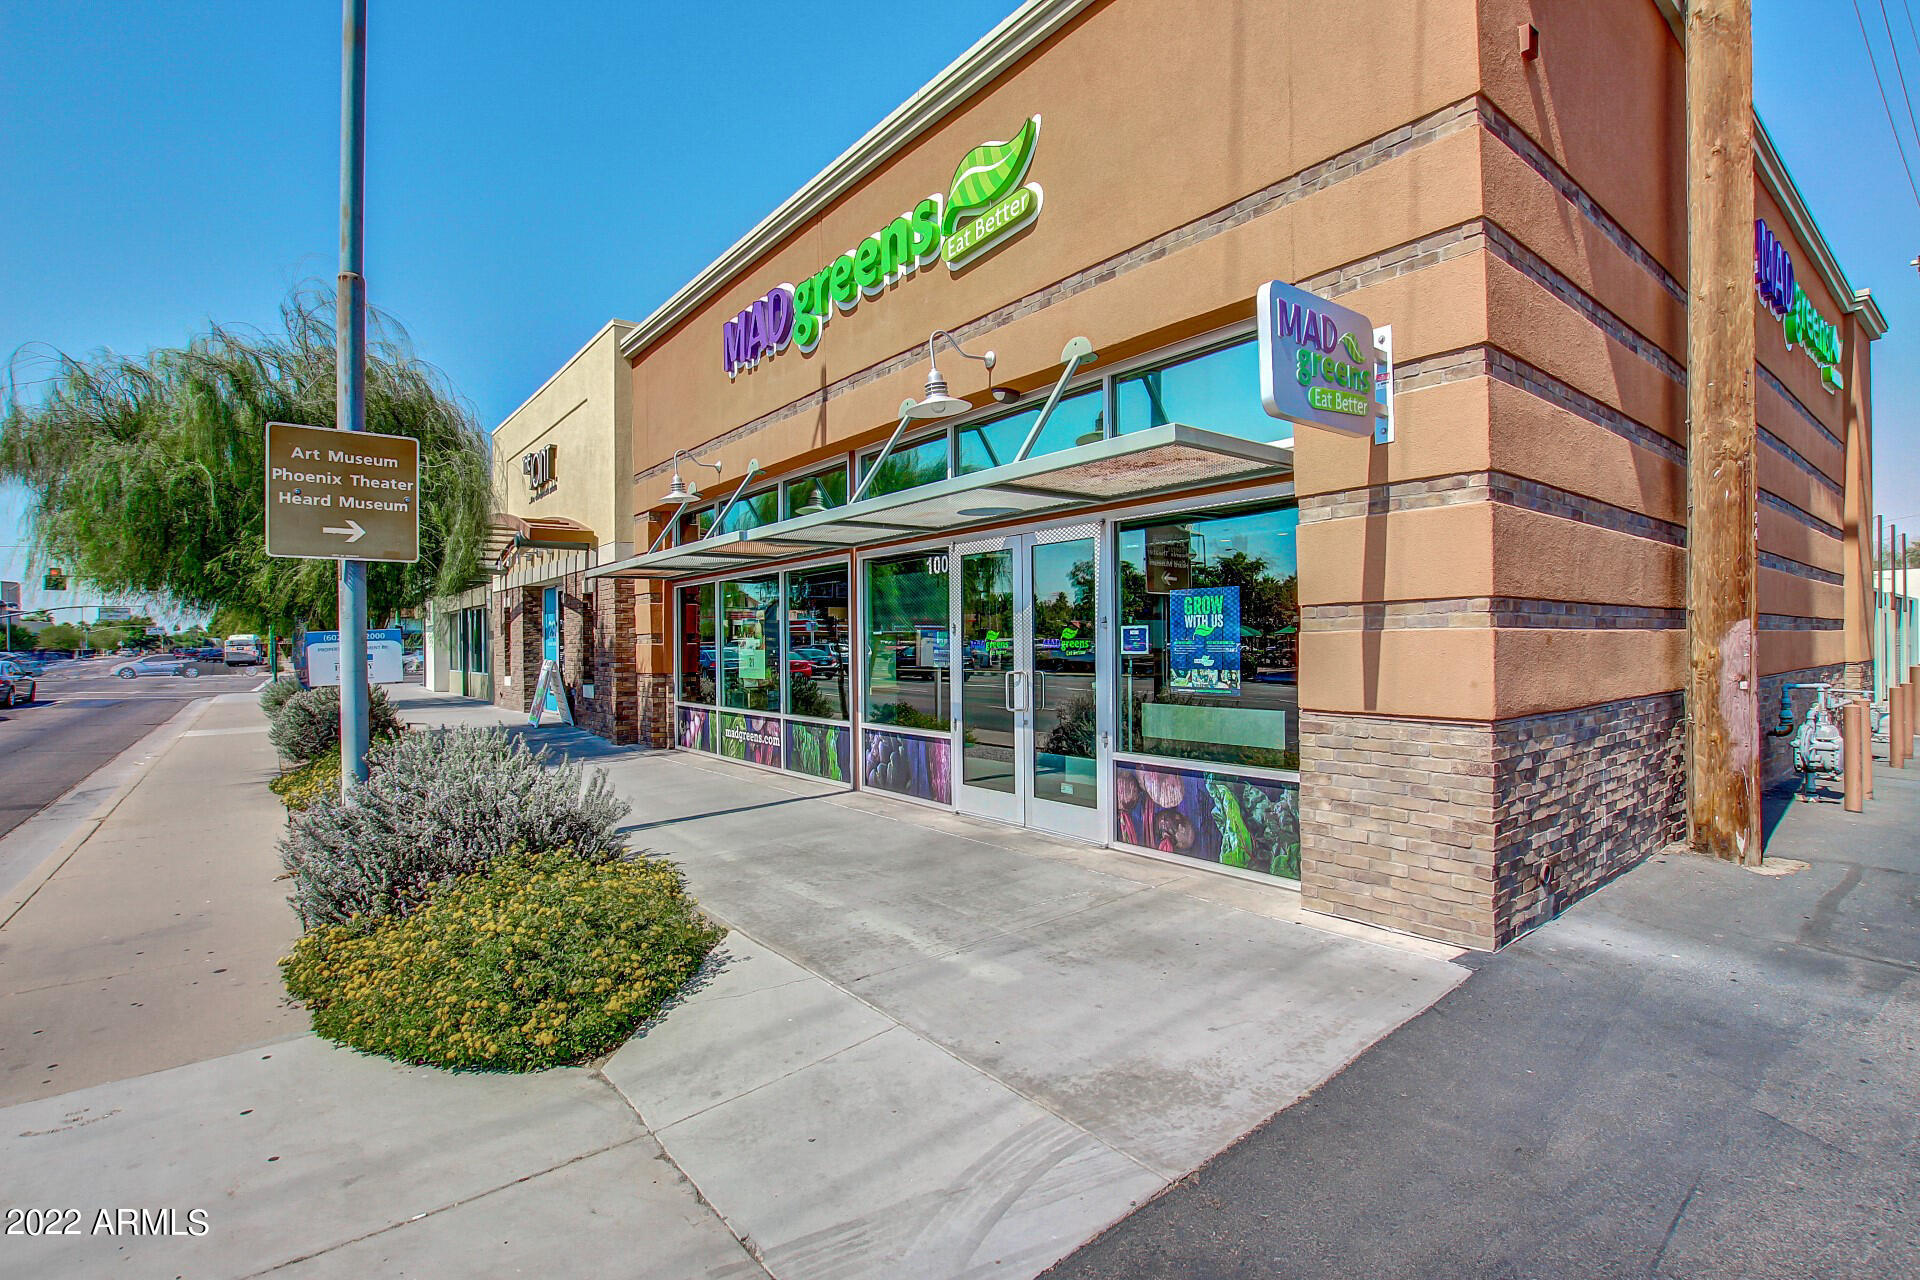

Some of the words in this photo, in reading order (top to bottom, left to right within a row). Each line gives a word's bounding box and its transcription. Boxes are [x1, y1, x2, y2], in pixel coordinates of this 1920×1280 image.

[946, 232, 971, 258] Eat
[975, 191, 1030, 239] Better
[1276, 297, 1338, 354] MAD
[1296, 348, 1371, 395] greens
[1314, 388, 1333, 409] Eat
[1335, 392, 1368, 415] Better
[291, 447, 321, 461] Art
[328, 450, 399, 468] Museum
[272, 467, 342, 485] Phoenix
[350, 474, 414, 491] Theater
[279, 491, 331, 507] Heard
[339, 496, 409, 512] Museum
[926, 555, 949, 575] 100
[1184, 595, 1224, 615] GROW
[1184, 614, 1209, 628] WITH
[1211, 614, 1224, 628] US
[725, 726, 781, 747] madgreens.com
